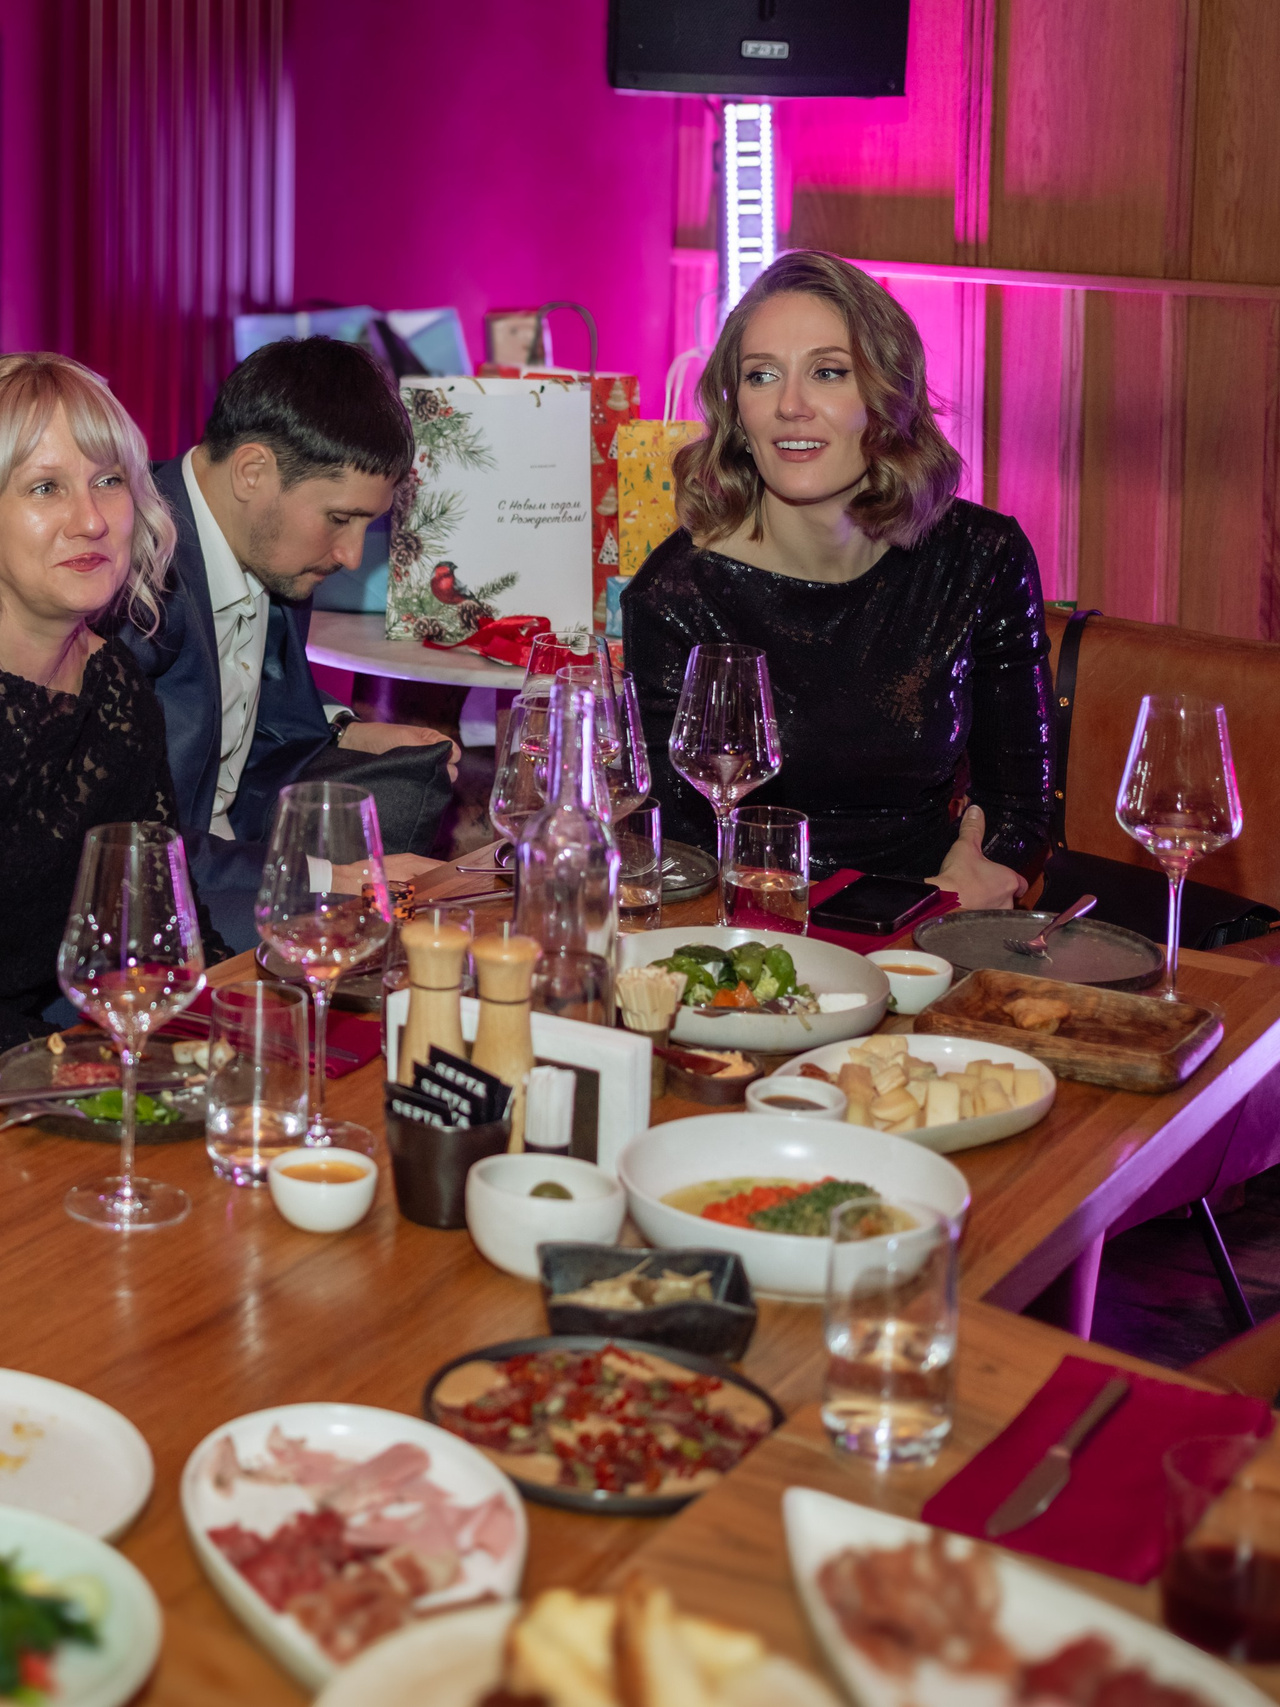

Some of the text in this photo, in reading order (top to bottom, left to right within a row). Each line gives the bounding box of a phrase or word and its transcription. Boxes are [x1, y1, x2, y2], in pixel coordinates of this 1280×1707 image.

[497, 498, 581, 515] С Новым годом
[497, 510, 588, 529] и Рождеством!
[434, 1061, 487, 1099] SEPTA
[420, 1077, 472, 1116] SEPTA
[391, 1098, 445, 1130] SEPTA
